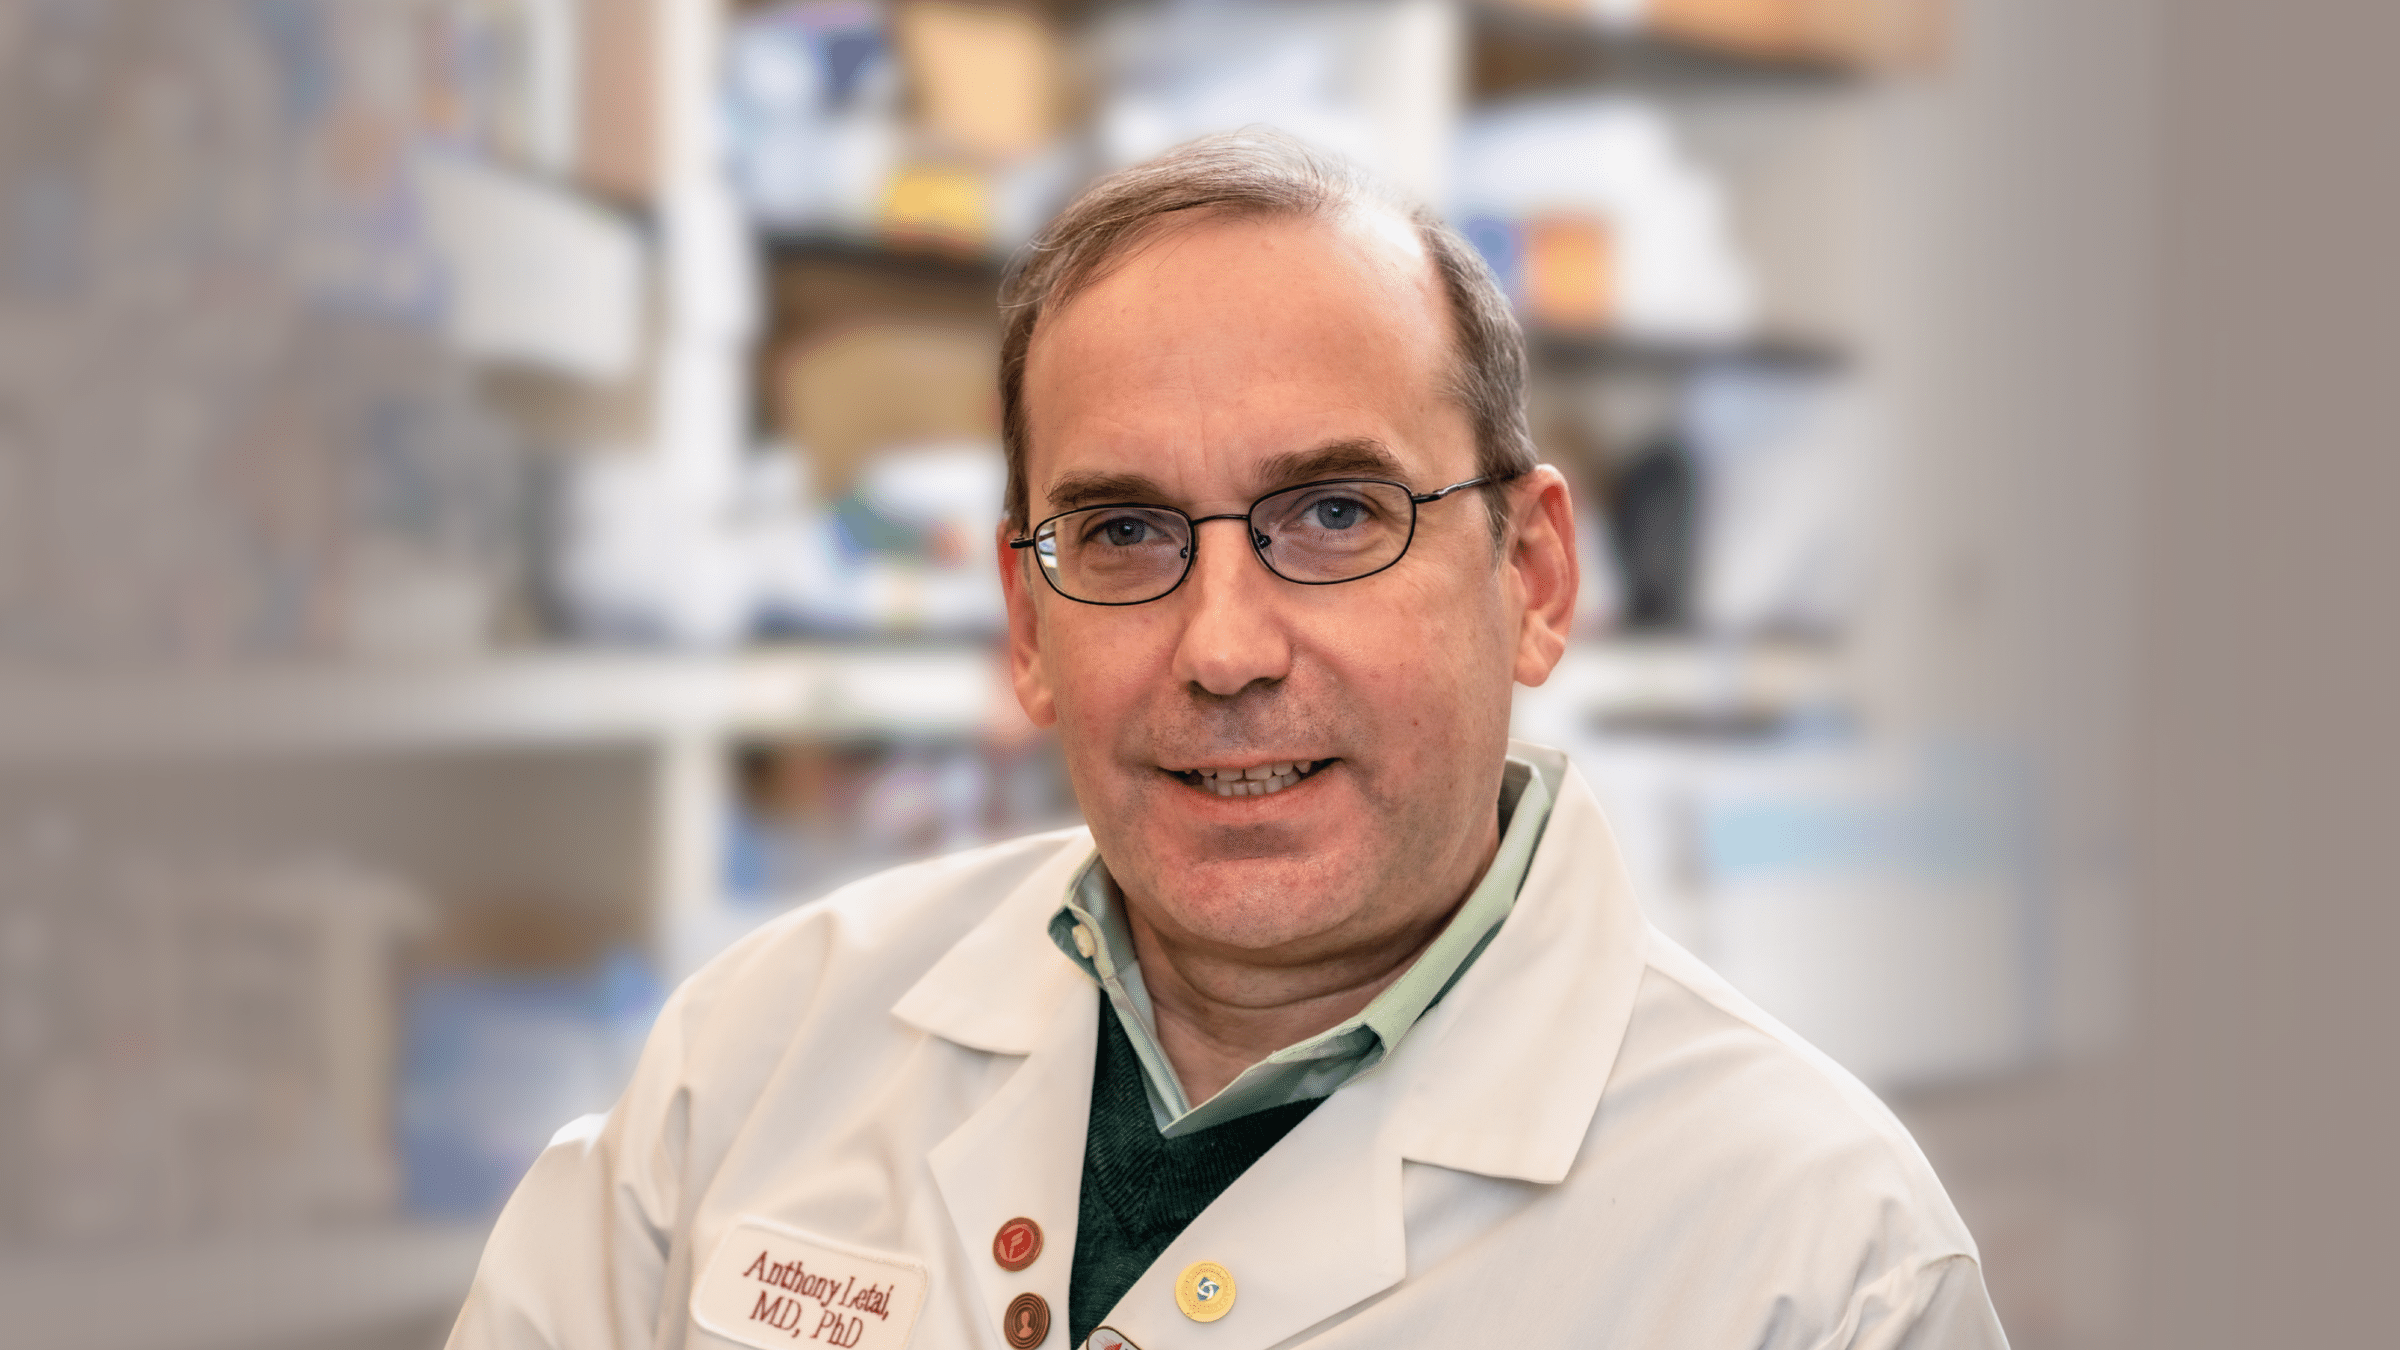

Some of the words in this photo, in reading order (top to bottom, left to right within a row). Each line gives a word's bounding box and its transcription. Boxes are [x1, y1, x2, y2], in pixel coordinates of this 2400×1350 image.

[743, 1250, 842, 1308] Anthony
[838, 1276, 894, 1321] Letai,
[750, 1290, 802, 1339] MD,
[810, 1309, 864, 1349] PhD
